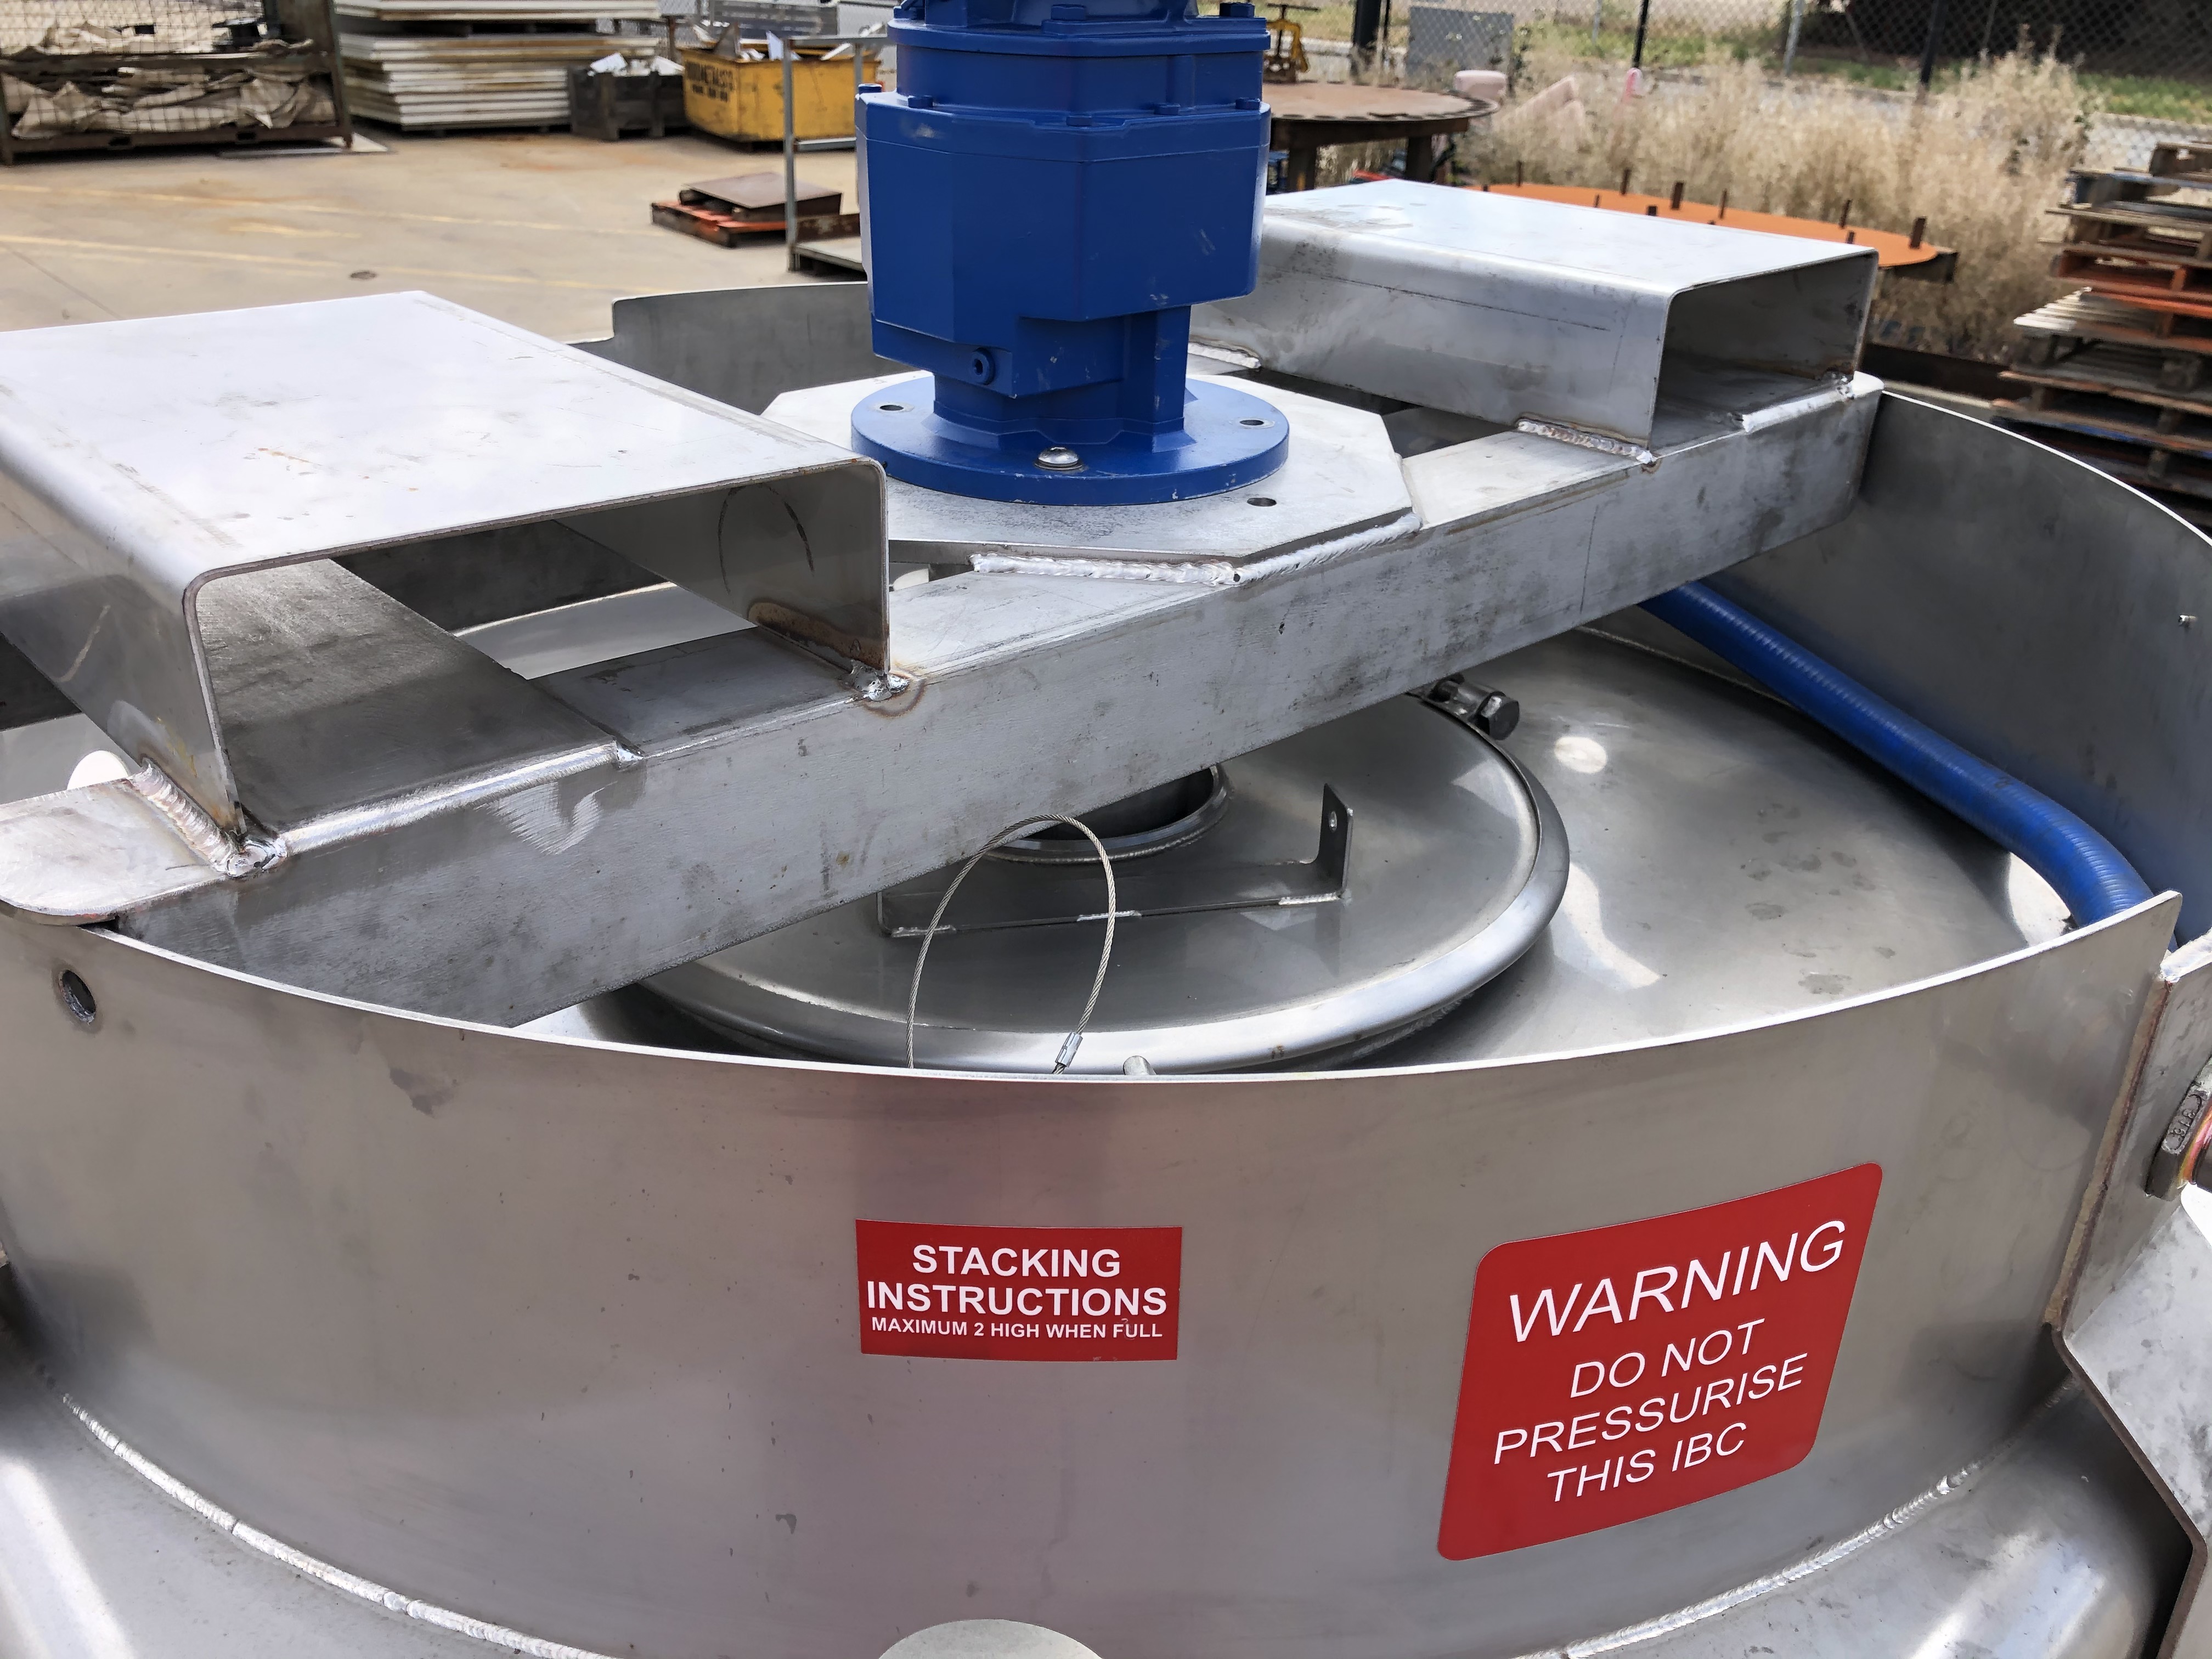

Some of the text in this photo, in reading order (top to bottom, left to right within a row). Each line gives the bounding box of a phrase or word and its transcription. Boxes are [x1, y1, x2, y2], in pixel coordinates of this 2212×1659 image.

[867, 1280, 1166, 1316] INSTRUCTIONS
[912, 1244, 1120, 1277] STACKING
[1509, 1220, 1846, 1342] WARNING
[872, 1317, 1163, 1338] MAXIMUM 2 HIGH WHEN FULL
[1570, 1318, 1765, 1398] DO NOT
[1494, 1352, 1808, 1465] PRESSURISE
[1547, 1422, 1747, 1502] THIS IBC
